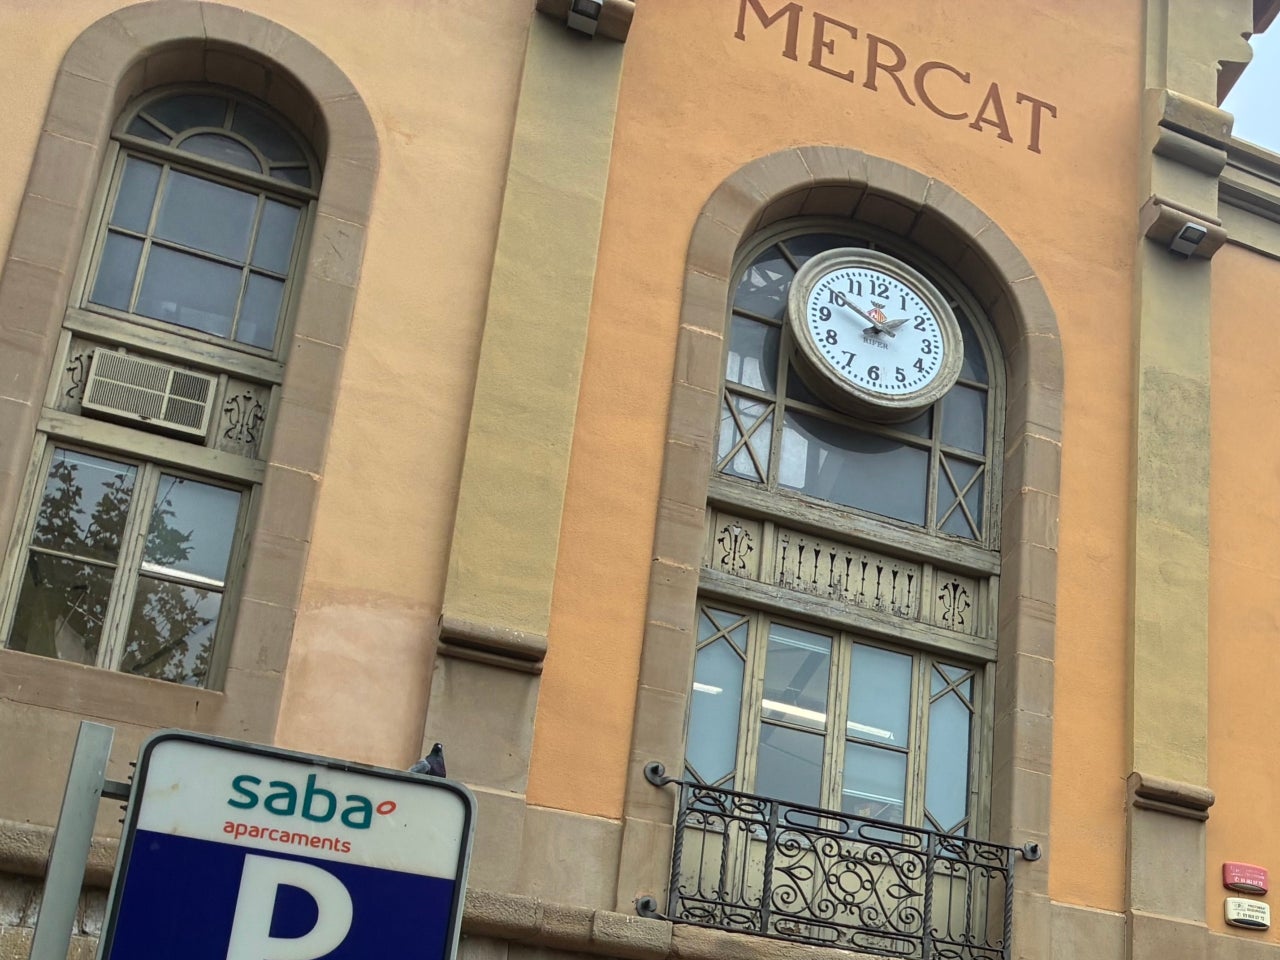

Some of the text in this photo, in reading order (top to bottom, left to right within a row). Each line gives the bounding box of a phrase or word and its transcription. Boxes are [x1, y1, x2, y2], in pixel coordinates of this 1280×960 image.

[734, 0, 1057, 154] MERCAT
[847, 277, 863, 297] 11
[869, 279, 890, 300] 12
[828, 288, 847, 307] 10
[900, 294, 907, 311] 1
[819, 306, 832, 321] 9
[914, 315, 927, 332] 2
[826, 329, 838, 345] 8
[921, 338, 932, 355] 3
[842, 350, 856, 367] 7
[913, 357, 925, 373] 4
[867, 365, 880, 381] 6
[895, 366, 906, 383] 5
[223, 821, 352, 854] aparcaments
